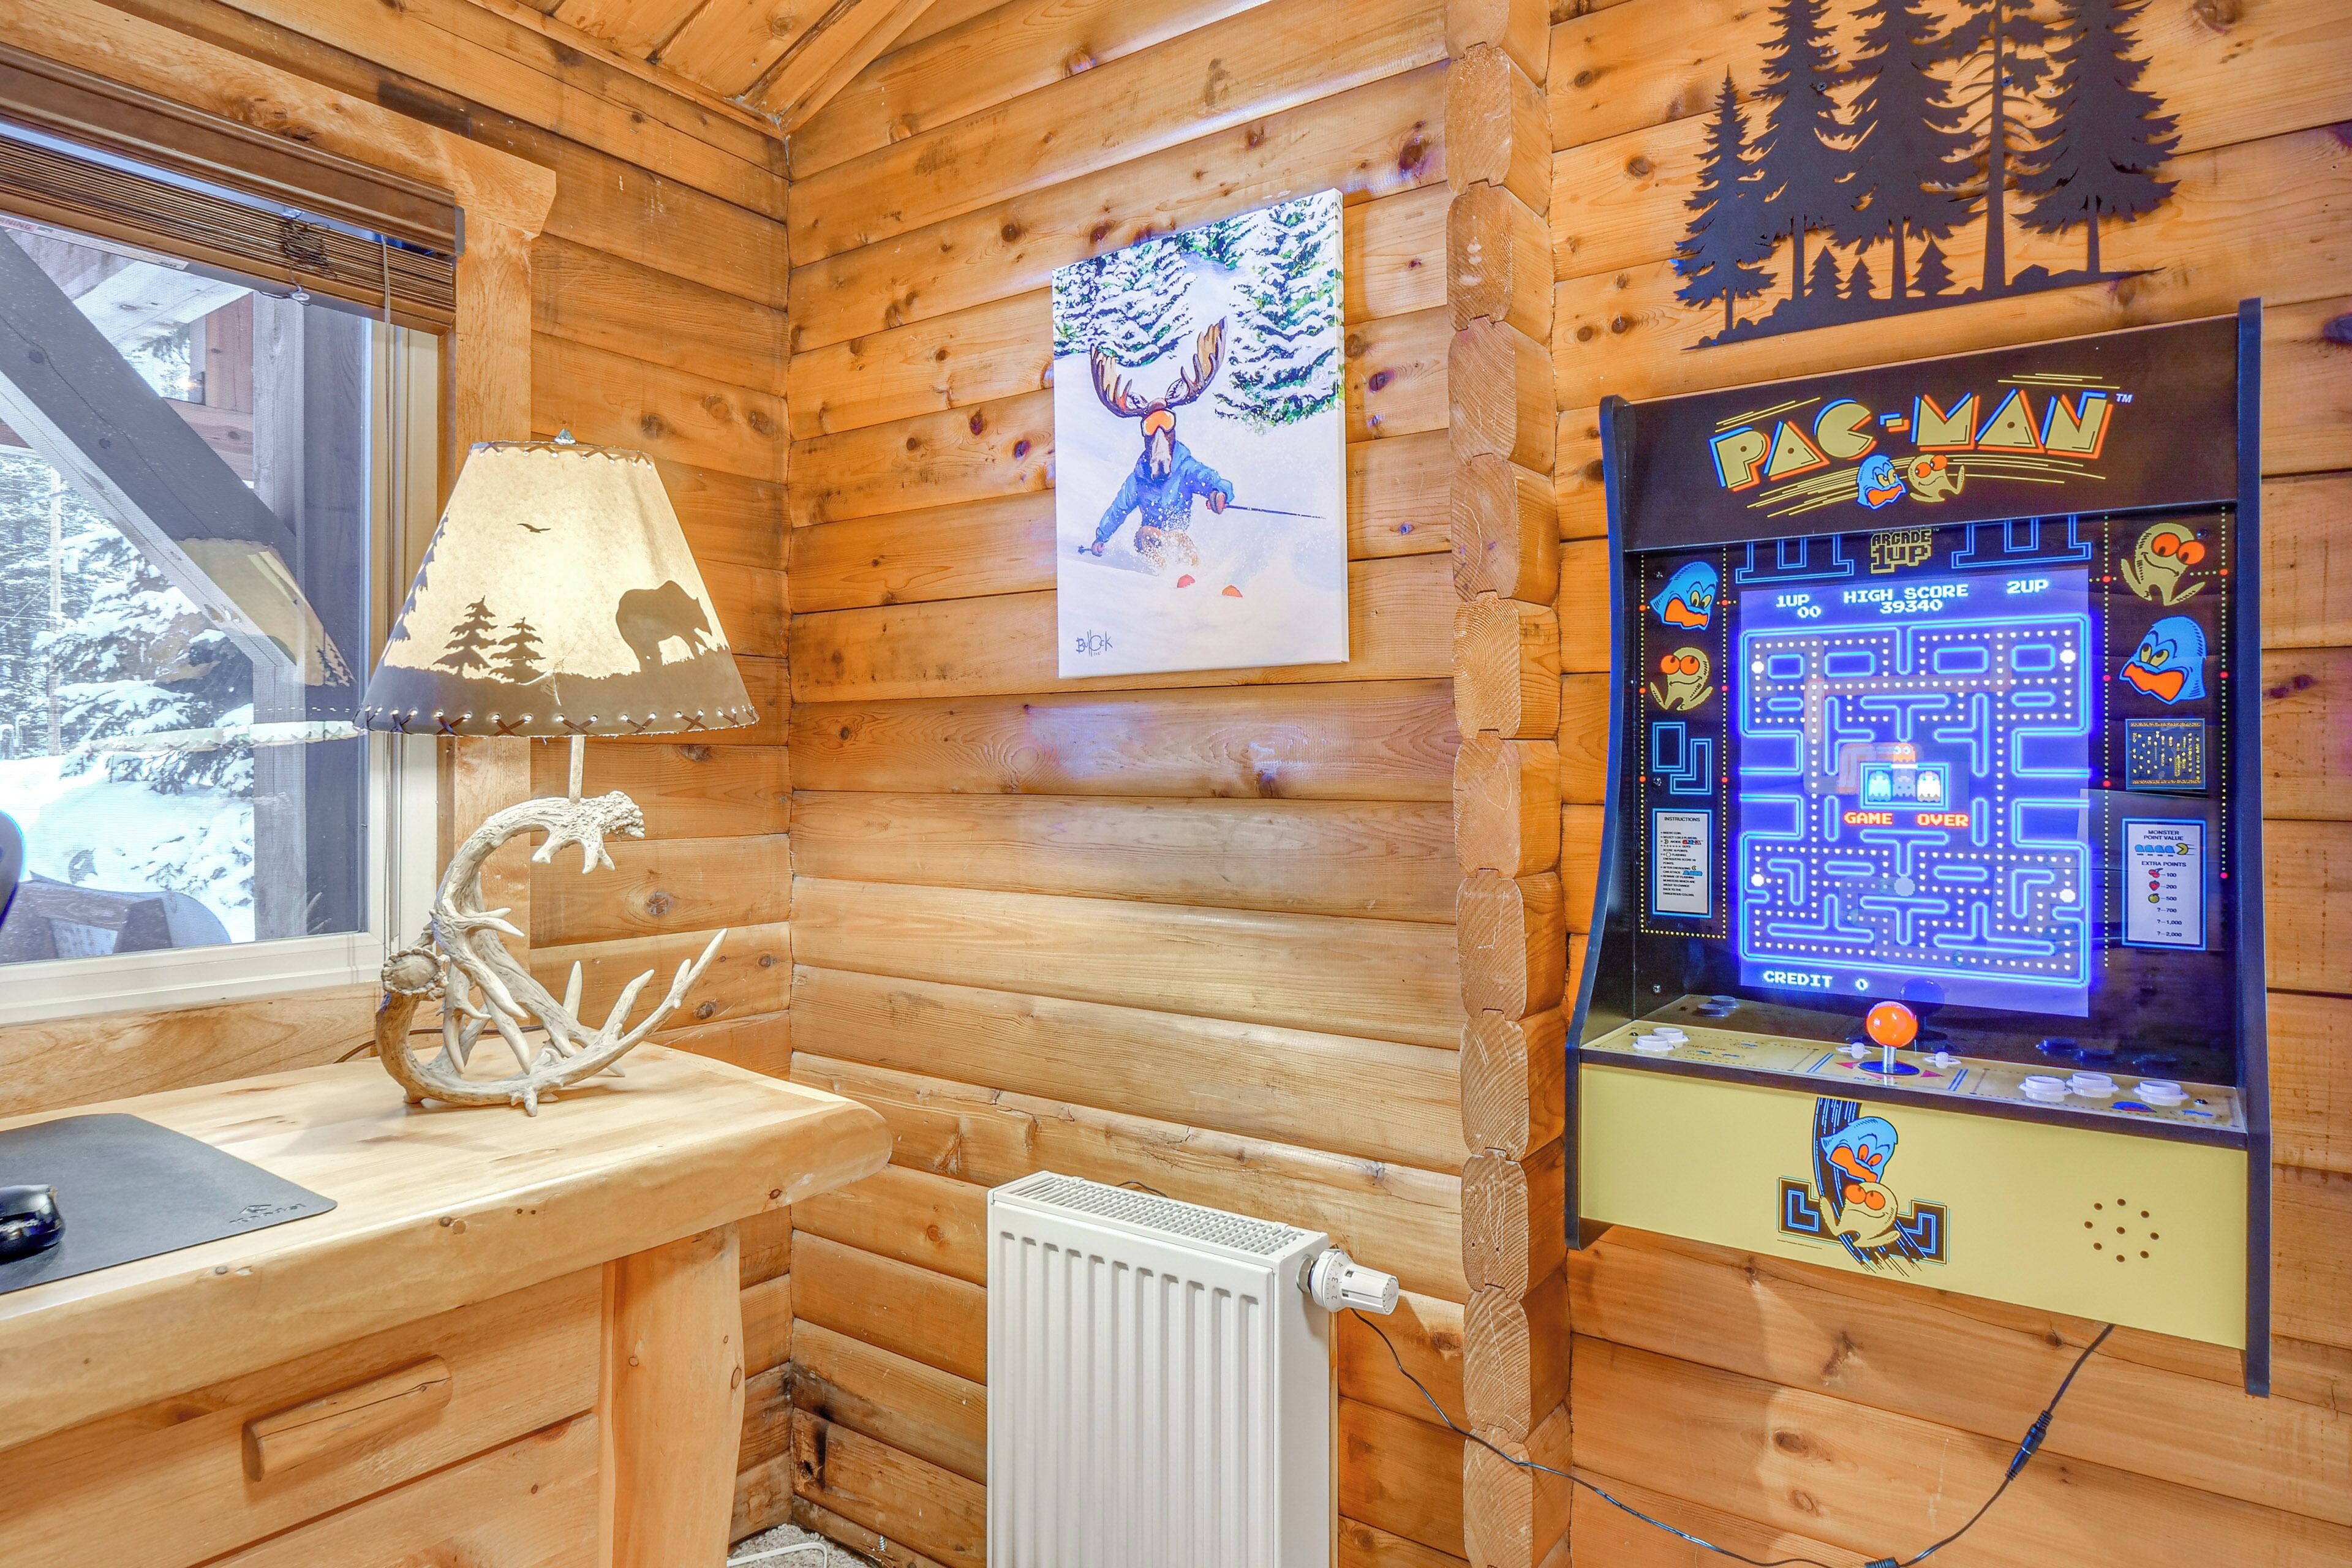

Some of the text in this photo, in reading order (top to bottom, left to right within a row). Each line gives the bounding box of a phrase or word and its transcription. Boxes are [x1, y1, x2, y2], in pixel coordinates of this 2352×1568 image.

[1709, 389, 2113, 492] PAC-MAN
[1871, 529, 1931, 546] ARCADE
[1871, 544, 1931, 573] 1UP
[1776, 579, 2049, 608] 1UP HIGH SCORE 2UP
[1797, 598, 1943, 618] 00 39340
[1844, 812, 1970, 827] GAME OVER
[1763, 970, 1869, 991] CREDIT 0
